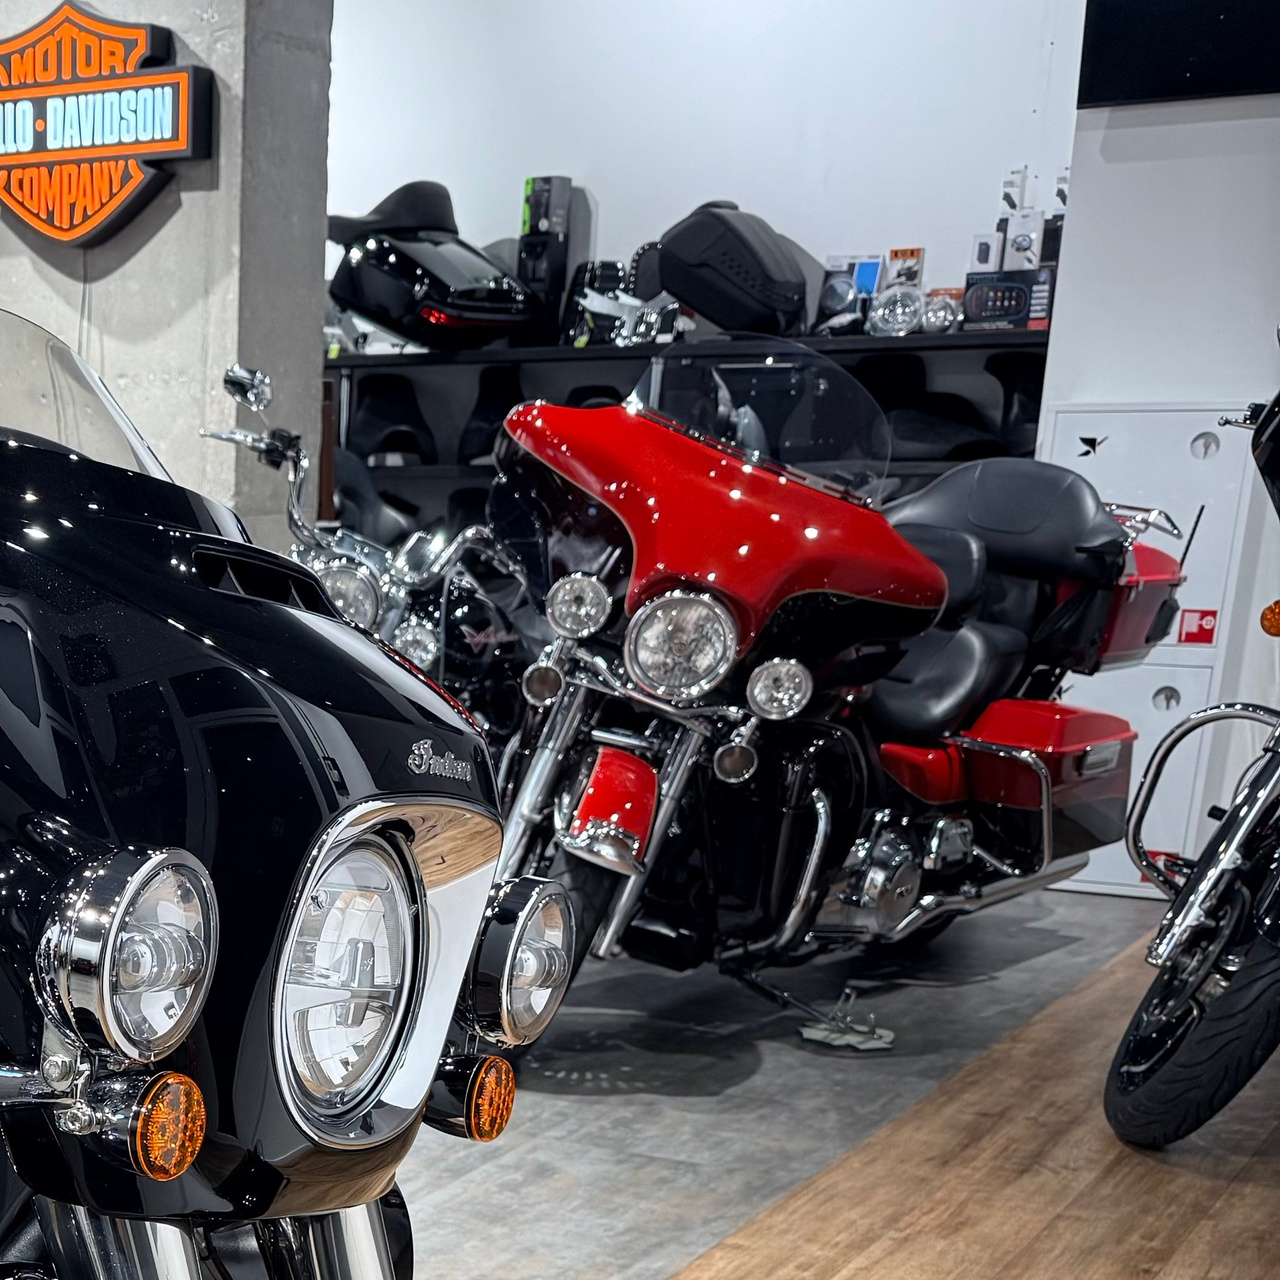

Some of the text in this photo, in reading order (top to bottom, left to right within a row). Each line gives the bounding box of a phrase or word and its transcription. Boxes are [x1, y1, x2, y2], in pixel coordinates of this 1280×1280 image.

[11, 22, 125, 85] MOTOR
[47, 86, 173, 149] DAVIDSON
[10, 160, 125, 229] COMPANY
[408, 739, 471, 781] Indian
